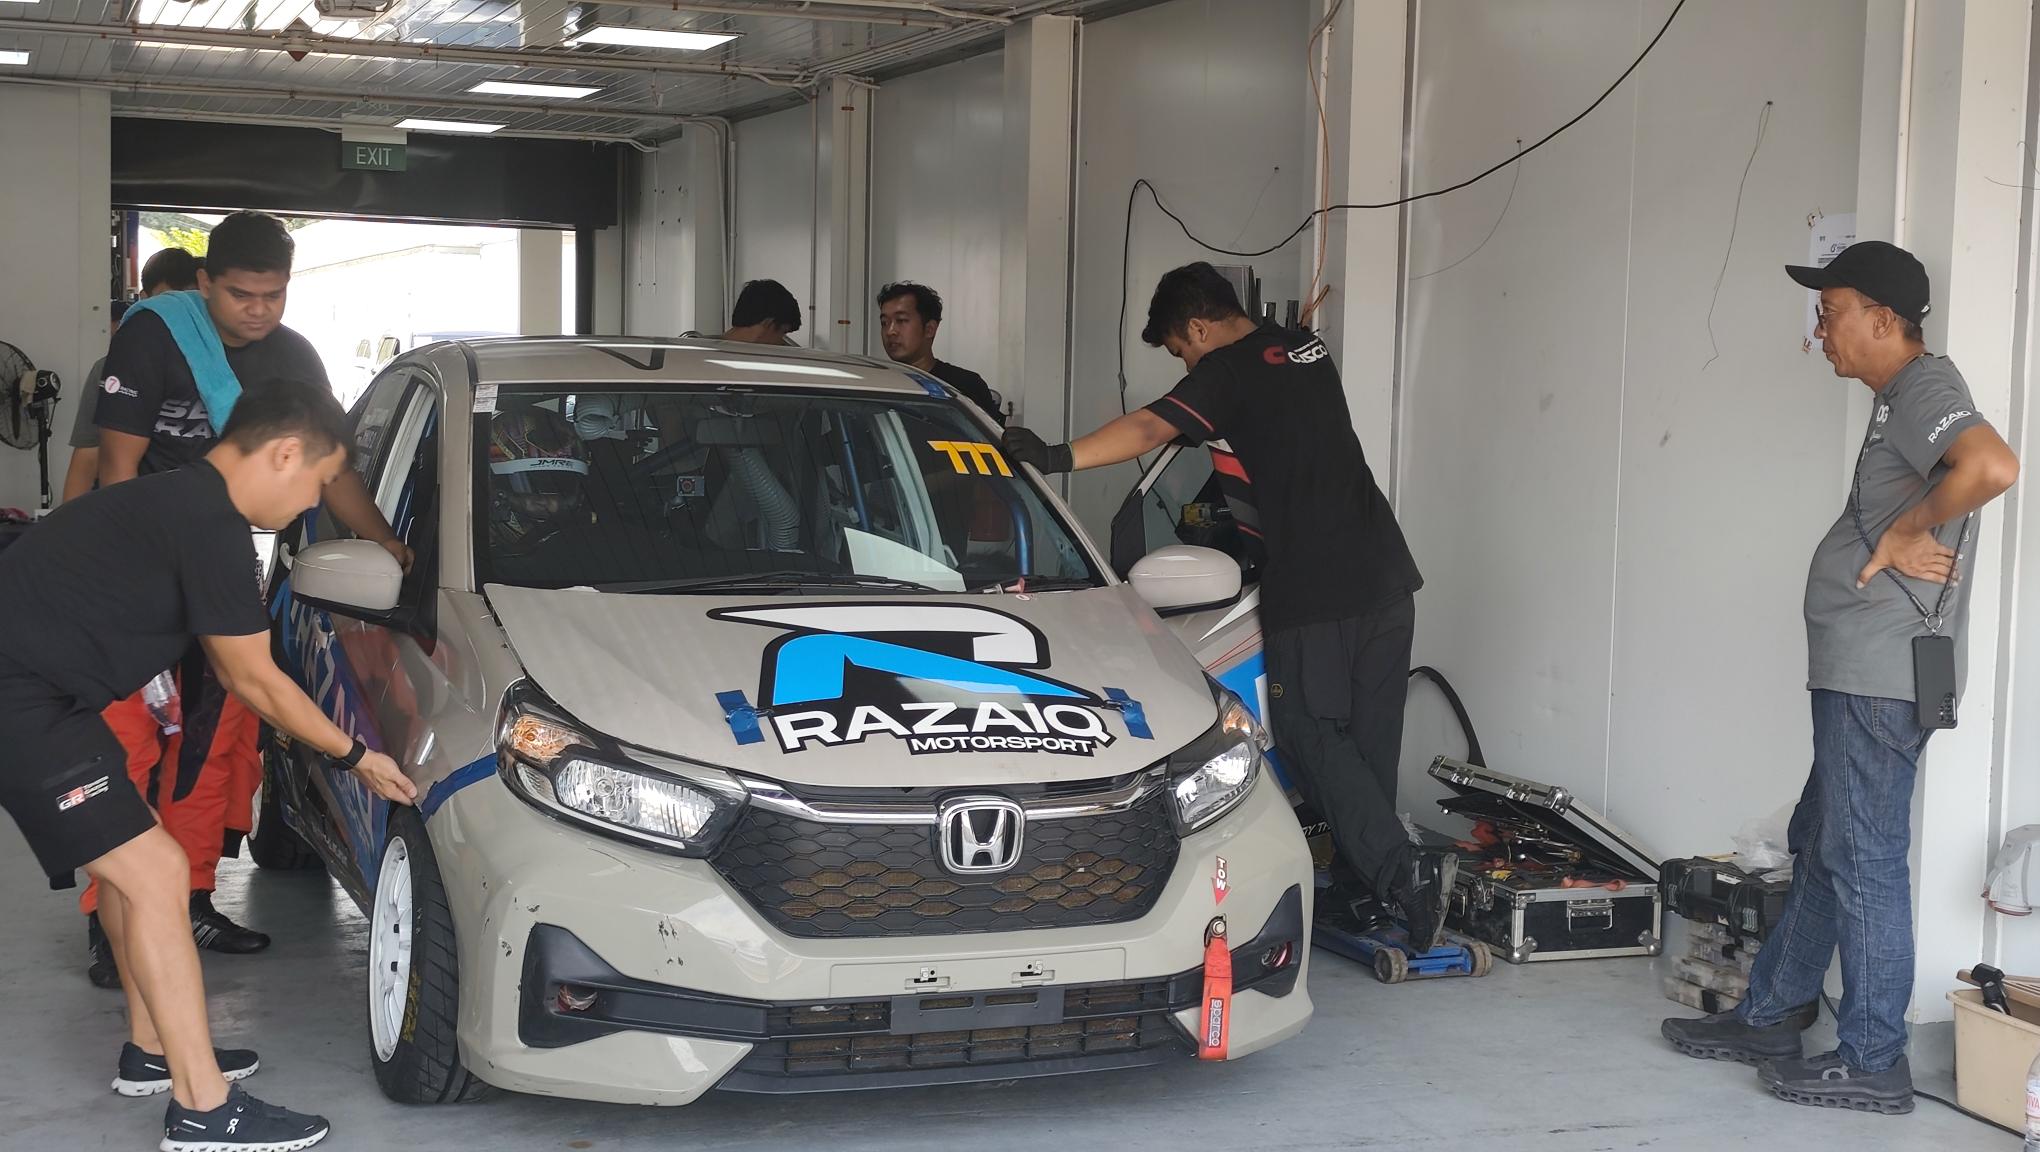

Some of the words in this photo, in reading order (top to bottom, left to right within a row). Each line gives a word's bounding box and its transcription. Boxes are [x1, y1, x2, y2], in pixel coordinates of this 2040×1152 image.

[356, 146, 392, 166] EXIT
[927, 440, 1014, 478] 777
[774, 701, 1110, 750] RAZAIQ
[910, 736, 1094, 753] MOTORSPORT
[1216, 857, 1226, 891] TOW
[1209, 999, 1223, 1047] sparco
